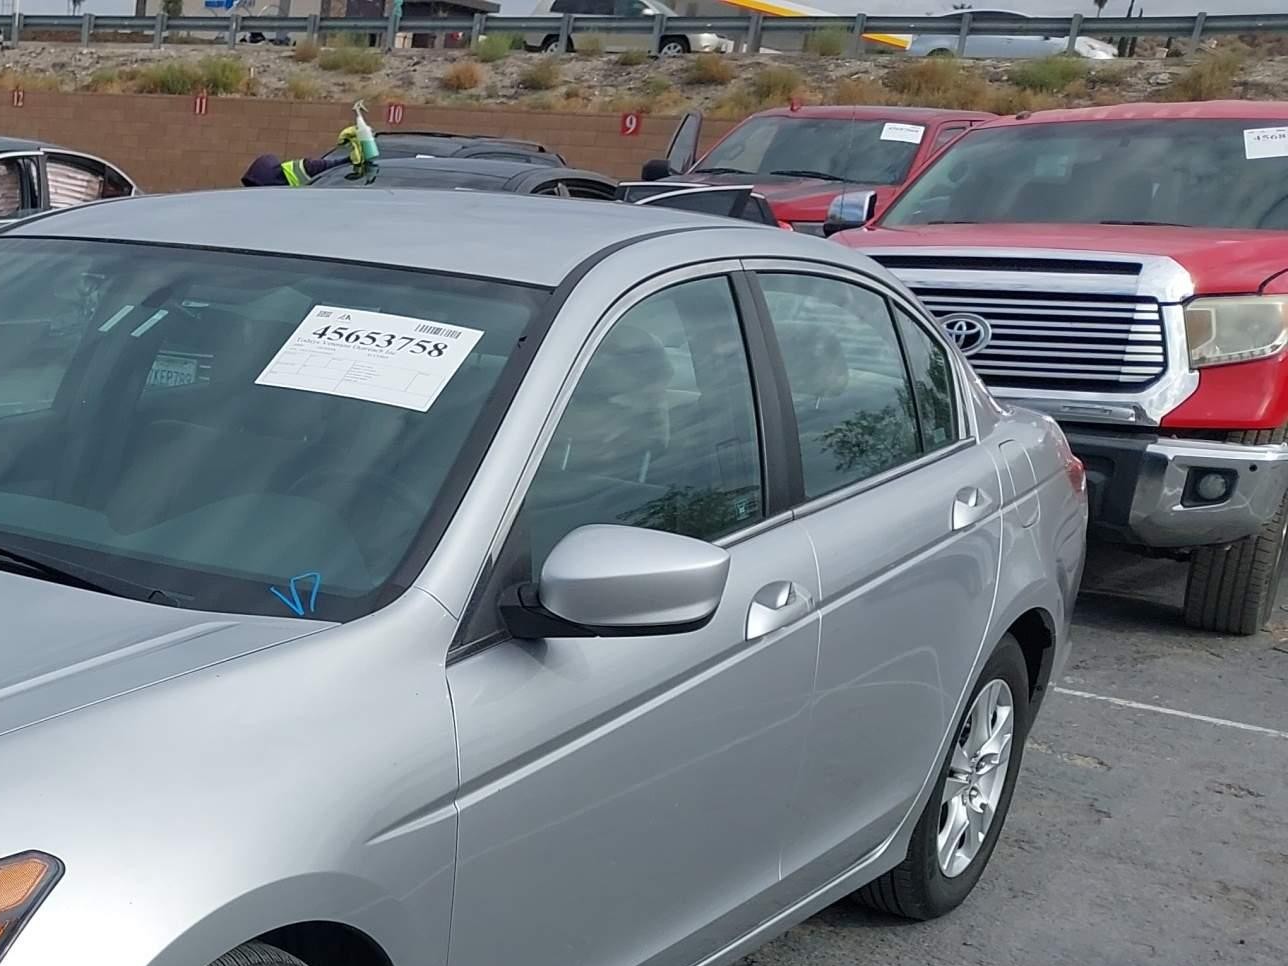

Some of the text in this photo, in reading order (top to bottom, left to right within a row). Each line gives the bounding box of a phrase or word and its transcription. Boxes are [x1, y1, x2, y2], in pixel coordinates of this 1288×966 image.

[13, 90, 23, 107] 12
[195, 97, 207, 115] 11
[388, 104, 403, 124] 10
[625, 114, 637, 134] 9
[312, 325, 448, 358] 45653758
